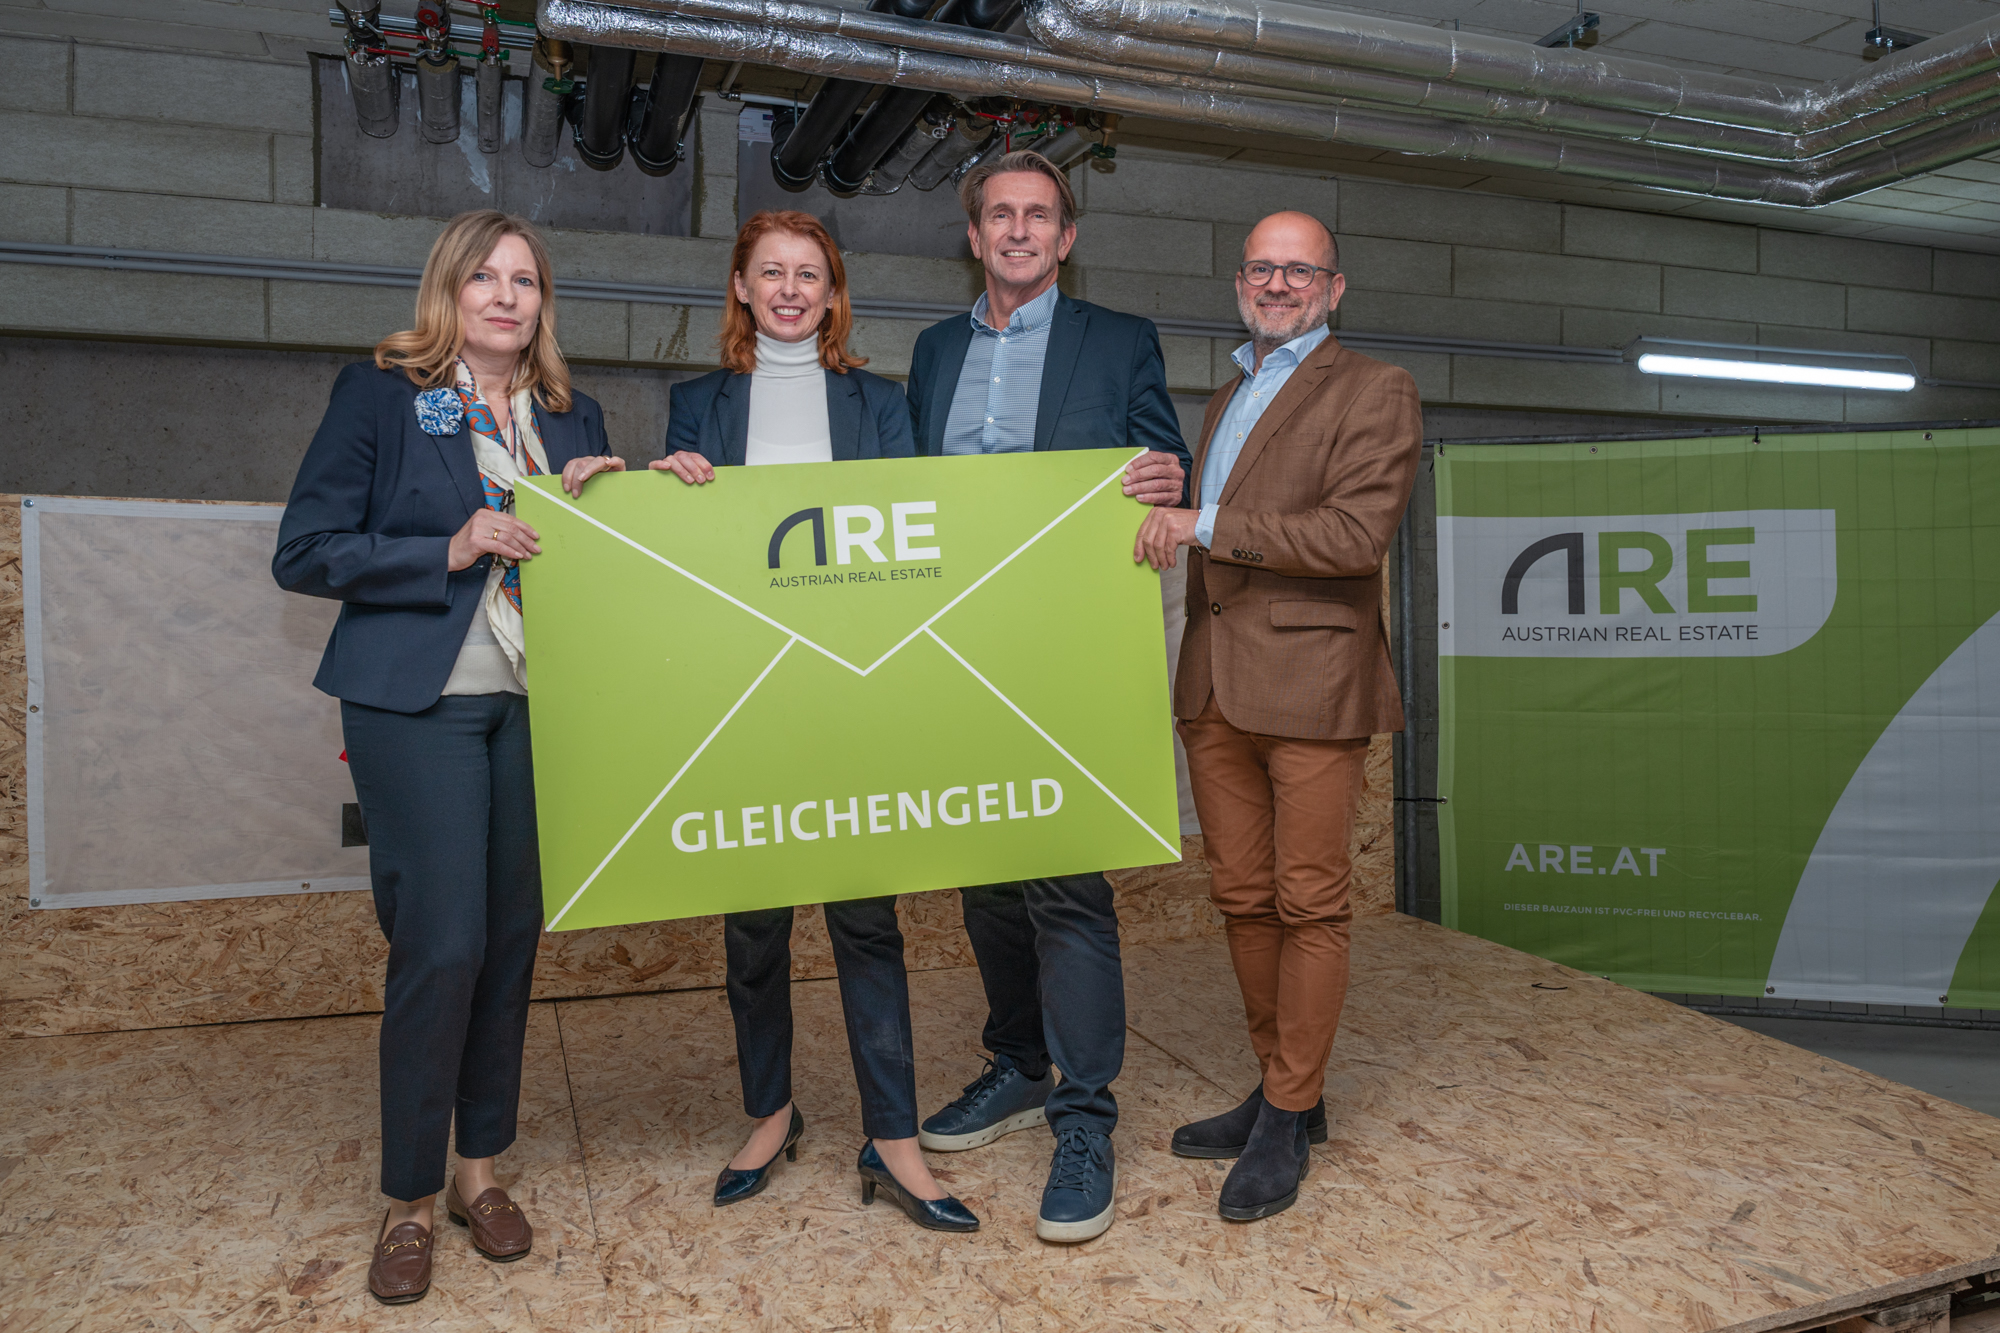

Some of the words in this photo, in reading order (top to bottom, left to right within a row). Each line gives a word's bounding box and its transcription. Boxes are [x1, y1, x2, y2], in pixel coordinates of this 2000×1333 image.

[768, 501, 941, 569] ARE
[769, 573, 844, 589] AUSTRIAN
[848, 569, 886, 583] REAL
[891, 567, 942, 581] ESTATE
[1501, 527, 1758, 615] ARE
[1502, 626, 1608, 642] AUSTRIAN
[1615, 626, 1671, 642] REAL
[1679, 624, 1759, 641] ESTATE
[671, 777, 1064, 853] GLEICHENGELD
[1504, 843, 1666, 877] ARE.AT
[1503, 903, 1540, 913] DIESER
[1542, 904, 1593, 915] BAUZAUN
[1594, 907, 1611, 916] IST
[1613, 908, 1661, 918] PVC-FREI
[1663, 910, 1686, 918] UND
[1688, 911, 1763, 922] RECYCLEBAR.
